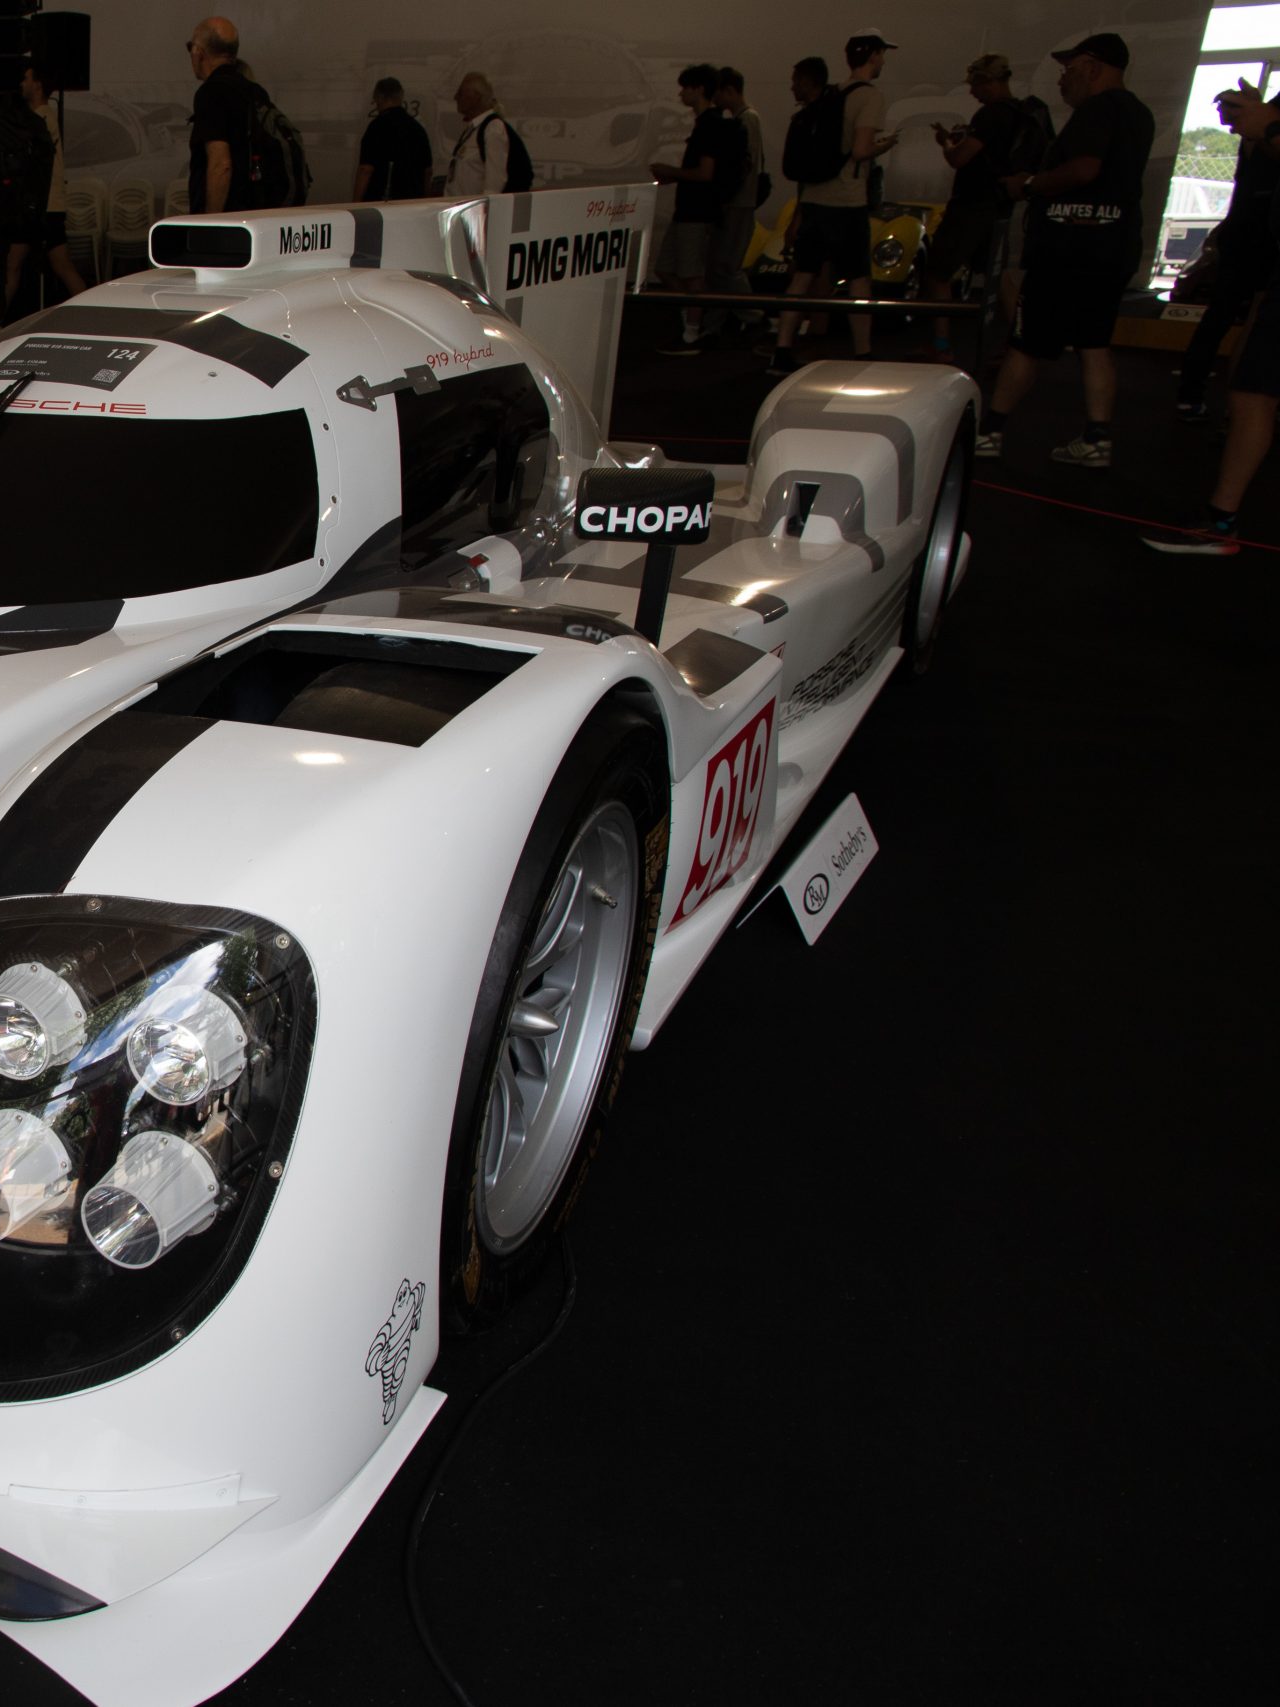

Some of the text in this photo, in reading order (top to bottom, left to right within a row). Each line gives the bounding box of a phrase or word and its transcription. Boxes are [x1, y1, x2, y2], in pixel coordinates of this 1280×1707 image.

[586, 200, 605, 218] 919
[1046, 203, 1094, 217] JANTES
[279, 223, 332, 255] Mobil 1
[506, 227, 631, 291] DMG MORI
[106, 348, 140, 361] 124
[426, 351, 449, 368] 919
[681, 717, 768, 916] 919
[831, 826, 867, 876] Sotheby's
